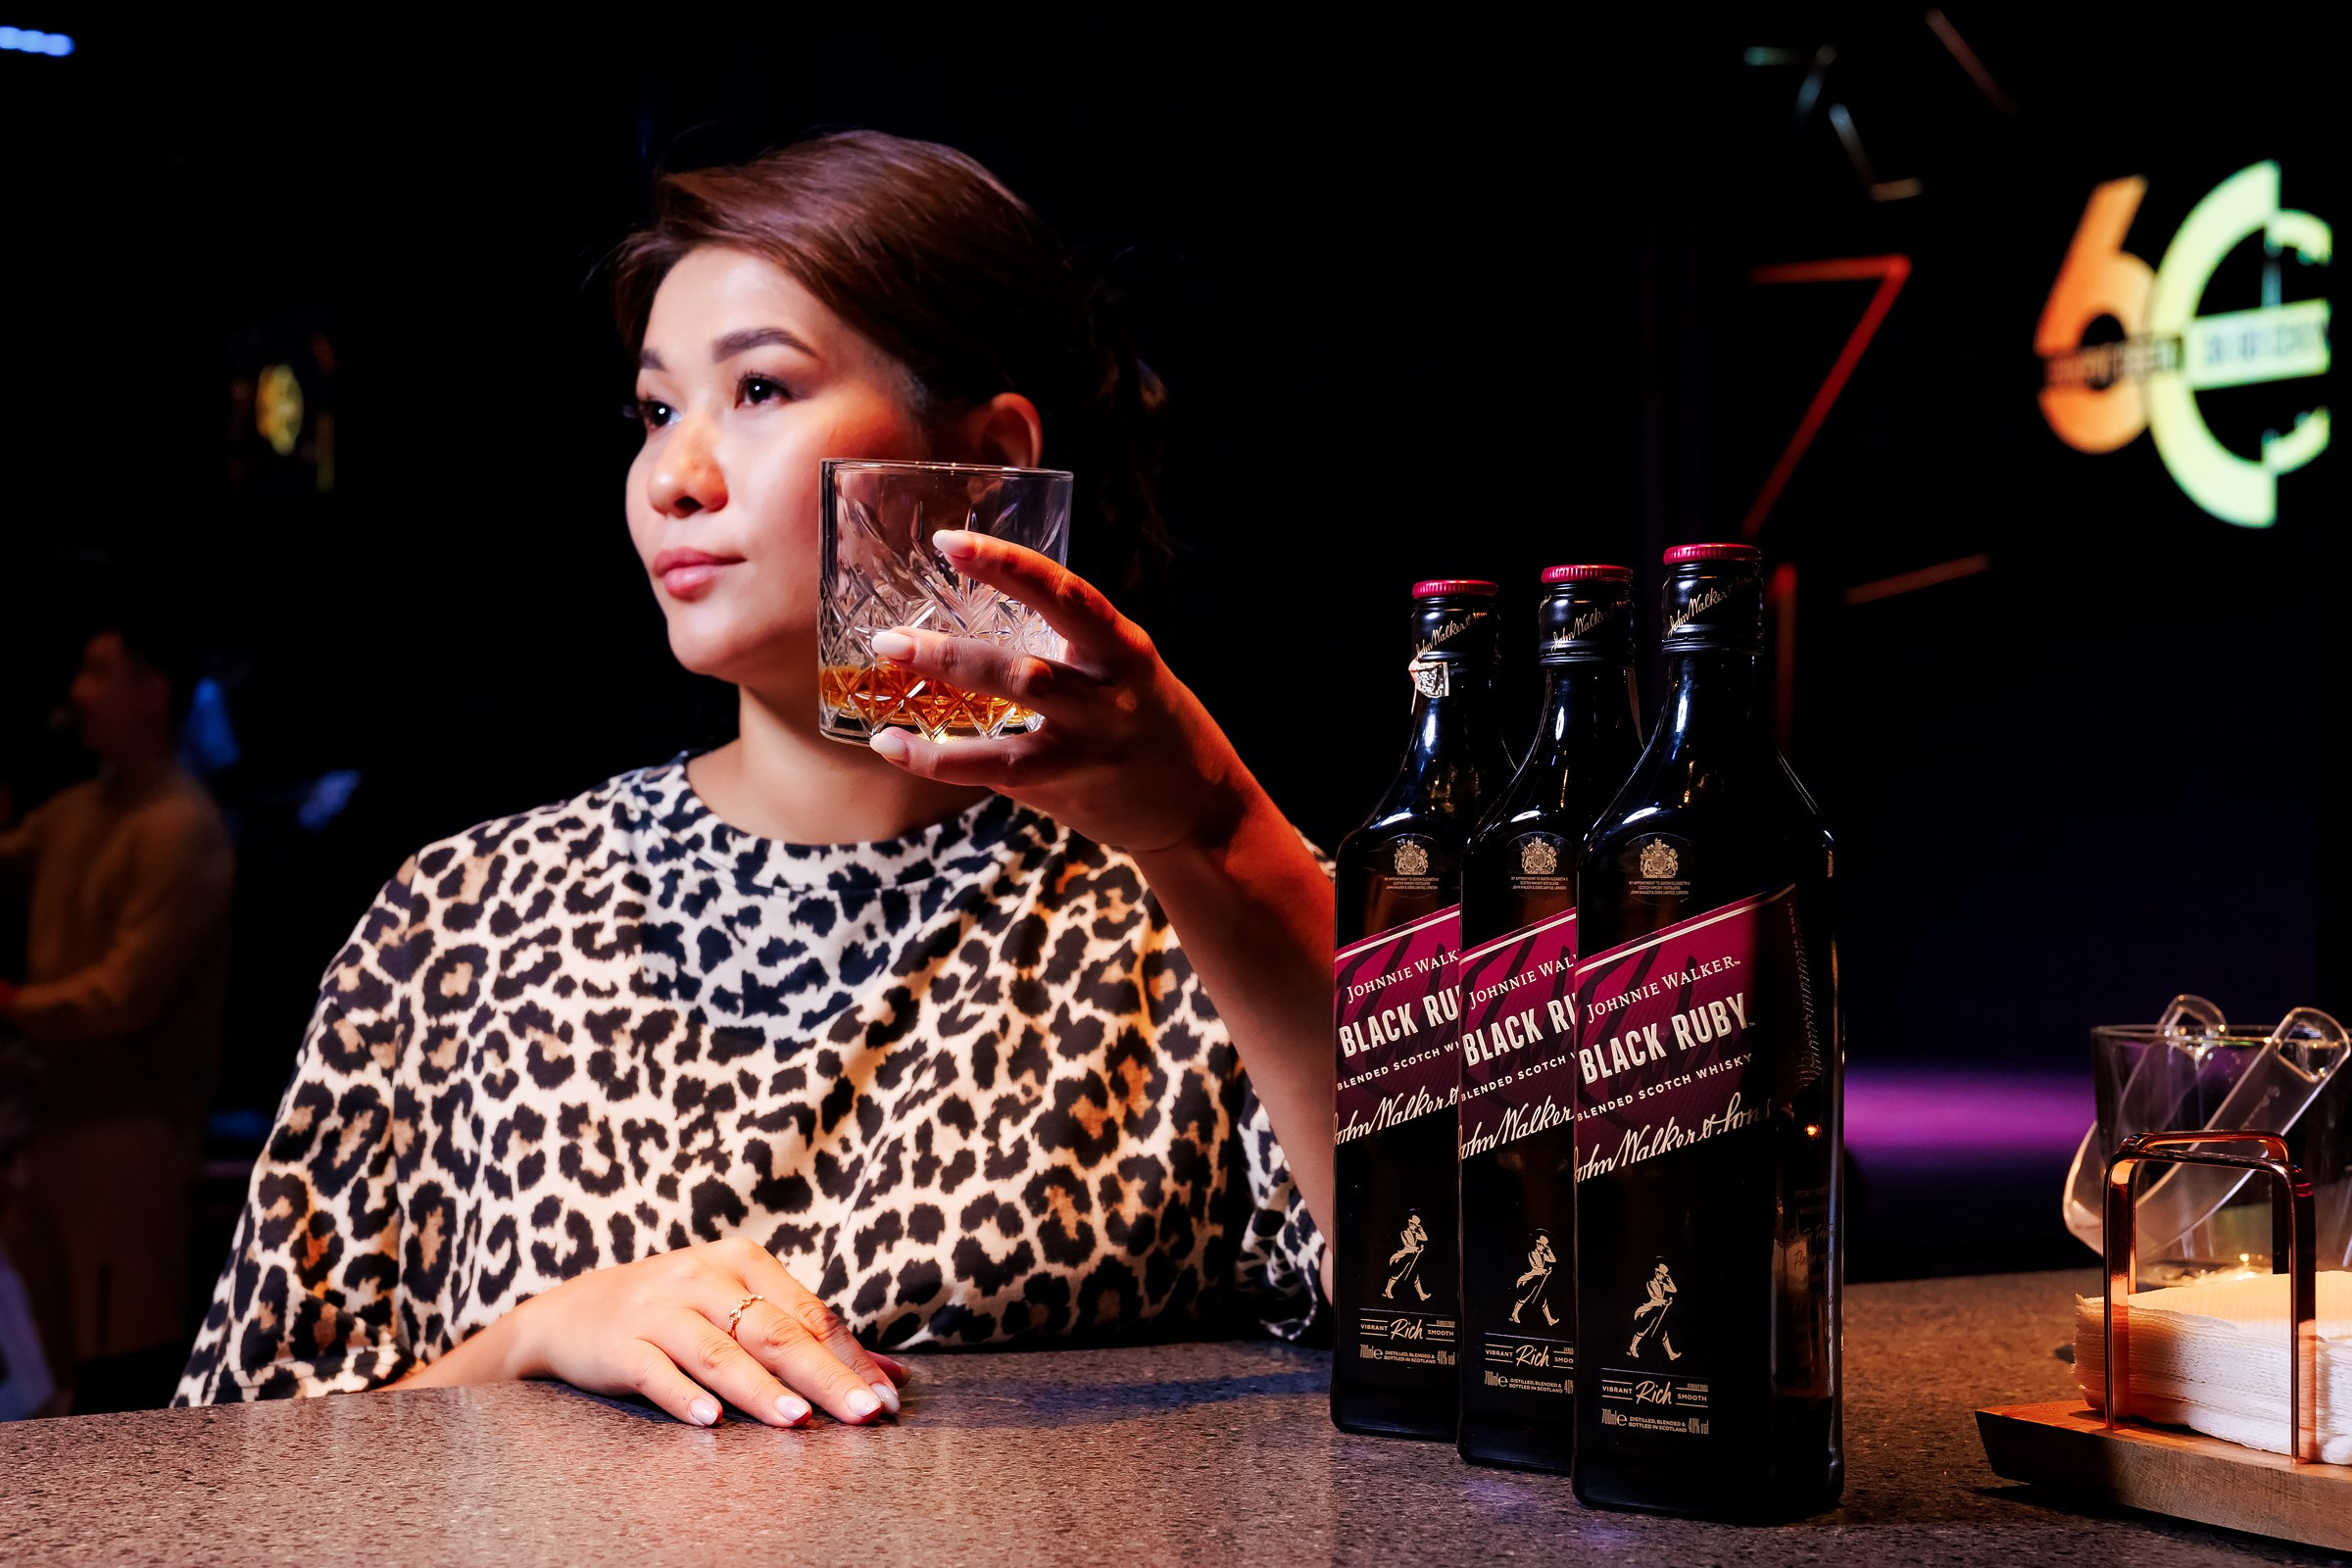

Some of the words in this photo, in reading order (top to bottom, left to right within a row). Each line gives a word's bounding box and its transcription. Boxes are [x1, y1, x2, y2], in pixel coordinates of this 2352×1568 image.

[1432, 620, 1466, 646] Walker
[1667, 610, 1690, 639] John
[1689, 587, 1728, 617] Walker
[1551, 627, 1575, 653] John
[1347, 966, 1413, 1004] JOHNNIE
[1414, 948, 1460, 973] WALK
[1469, 970, 1537, 1009] JOHNNIE
[1538, 955, 1576, 977] WAL
[1339, 1003, 1418, 1057] BLACK
[1422, 985, 1459, 1027] RU
[1587, 983, 1660, 1023] JOHNNIE
[1462, 1008, 1544, 1066] BLACK
[1579, 1023, 1667, 1085] BLACK
[1337, 1066, 1389, 1091] BLENDED
[1393, 1048, 1441, 1071] SCOTCH
[1461, 1075, 1513, 1102] BLENDED
[1517, 1055, 1566, 1080] SCOTCH
[1577, 1095, 1634, 1122] BLENDED
[1638, 1073, 1691, 1100] SCOTCH
[1695, 1053, 1752, 1079] WHISKY
[1372, 1085, 1445, 1131] Walker
[1494, 1095, 1575, 1145] Walker
[1614, 1116, 1695, 1167] Walker
[1390, 1318, 1423, 1340] Rich
[1485, 1348, 1513, 1357] VIBRANT
[1515, 1345, 1550, 1367] Rich
[1602, 1385, 1633, 1395] VIBRANT
[1635, 1380, 1672, 1405] Rich
[1677, 1393, 1707, 1402] SMOOTH
[1658, 1425, 1688, 1434] SCOTLAND
